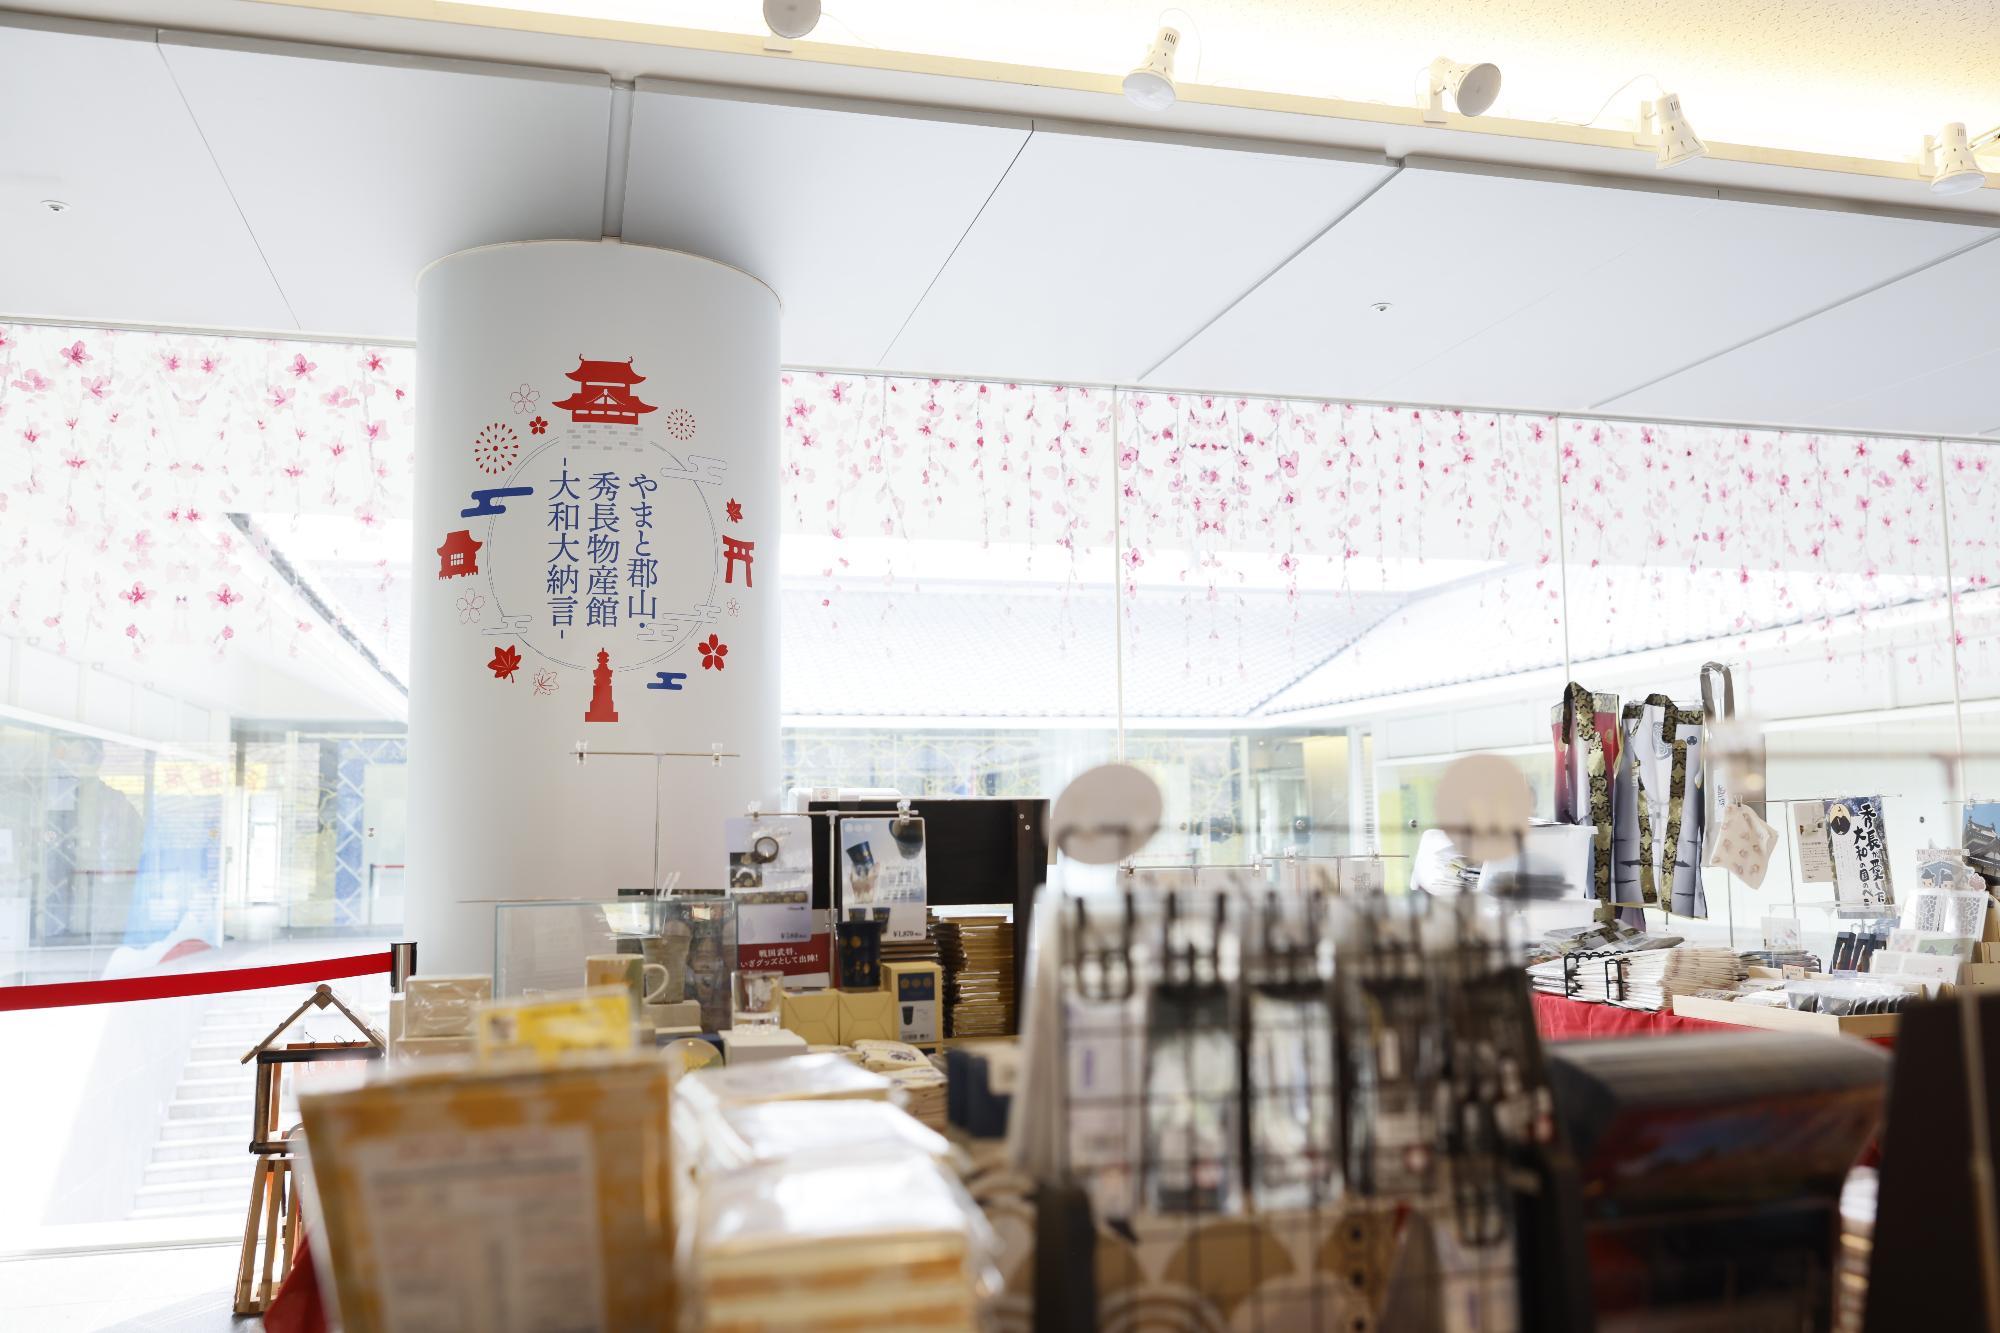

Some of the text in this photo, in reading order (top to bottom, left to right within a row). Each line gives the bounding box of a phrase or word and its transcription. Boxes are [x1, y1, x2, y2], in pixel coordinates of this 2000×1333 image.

[585, 471, 621, 629] 秀長物産館
